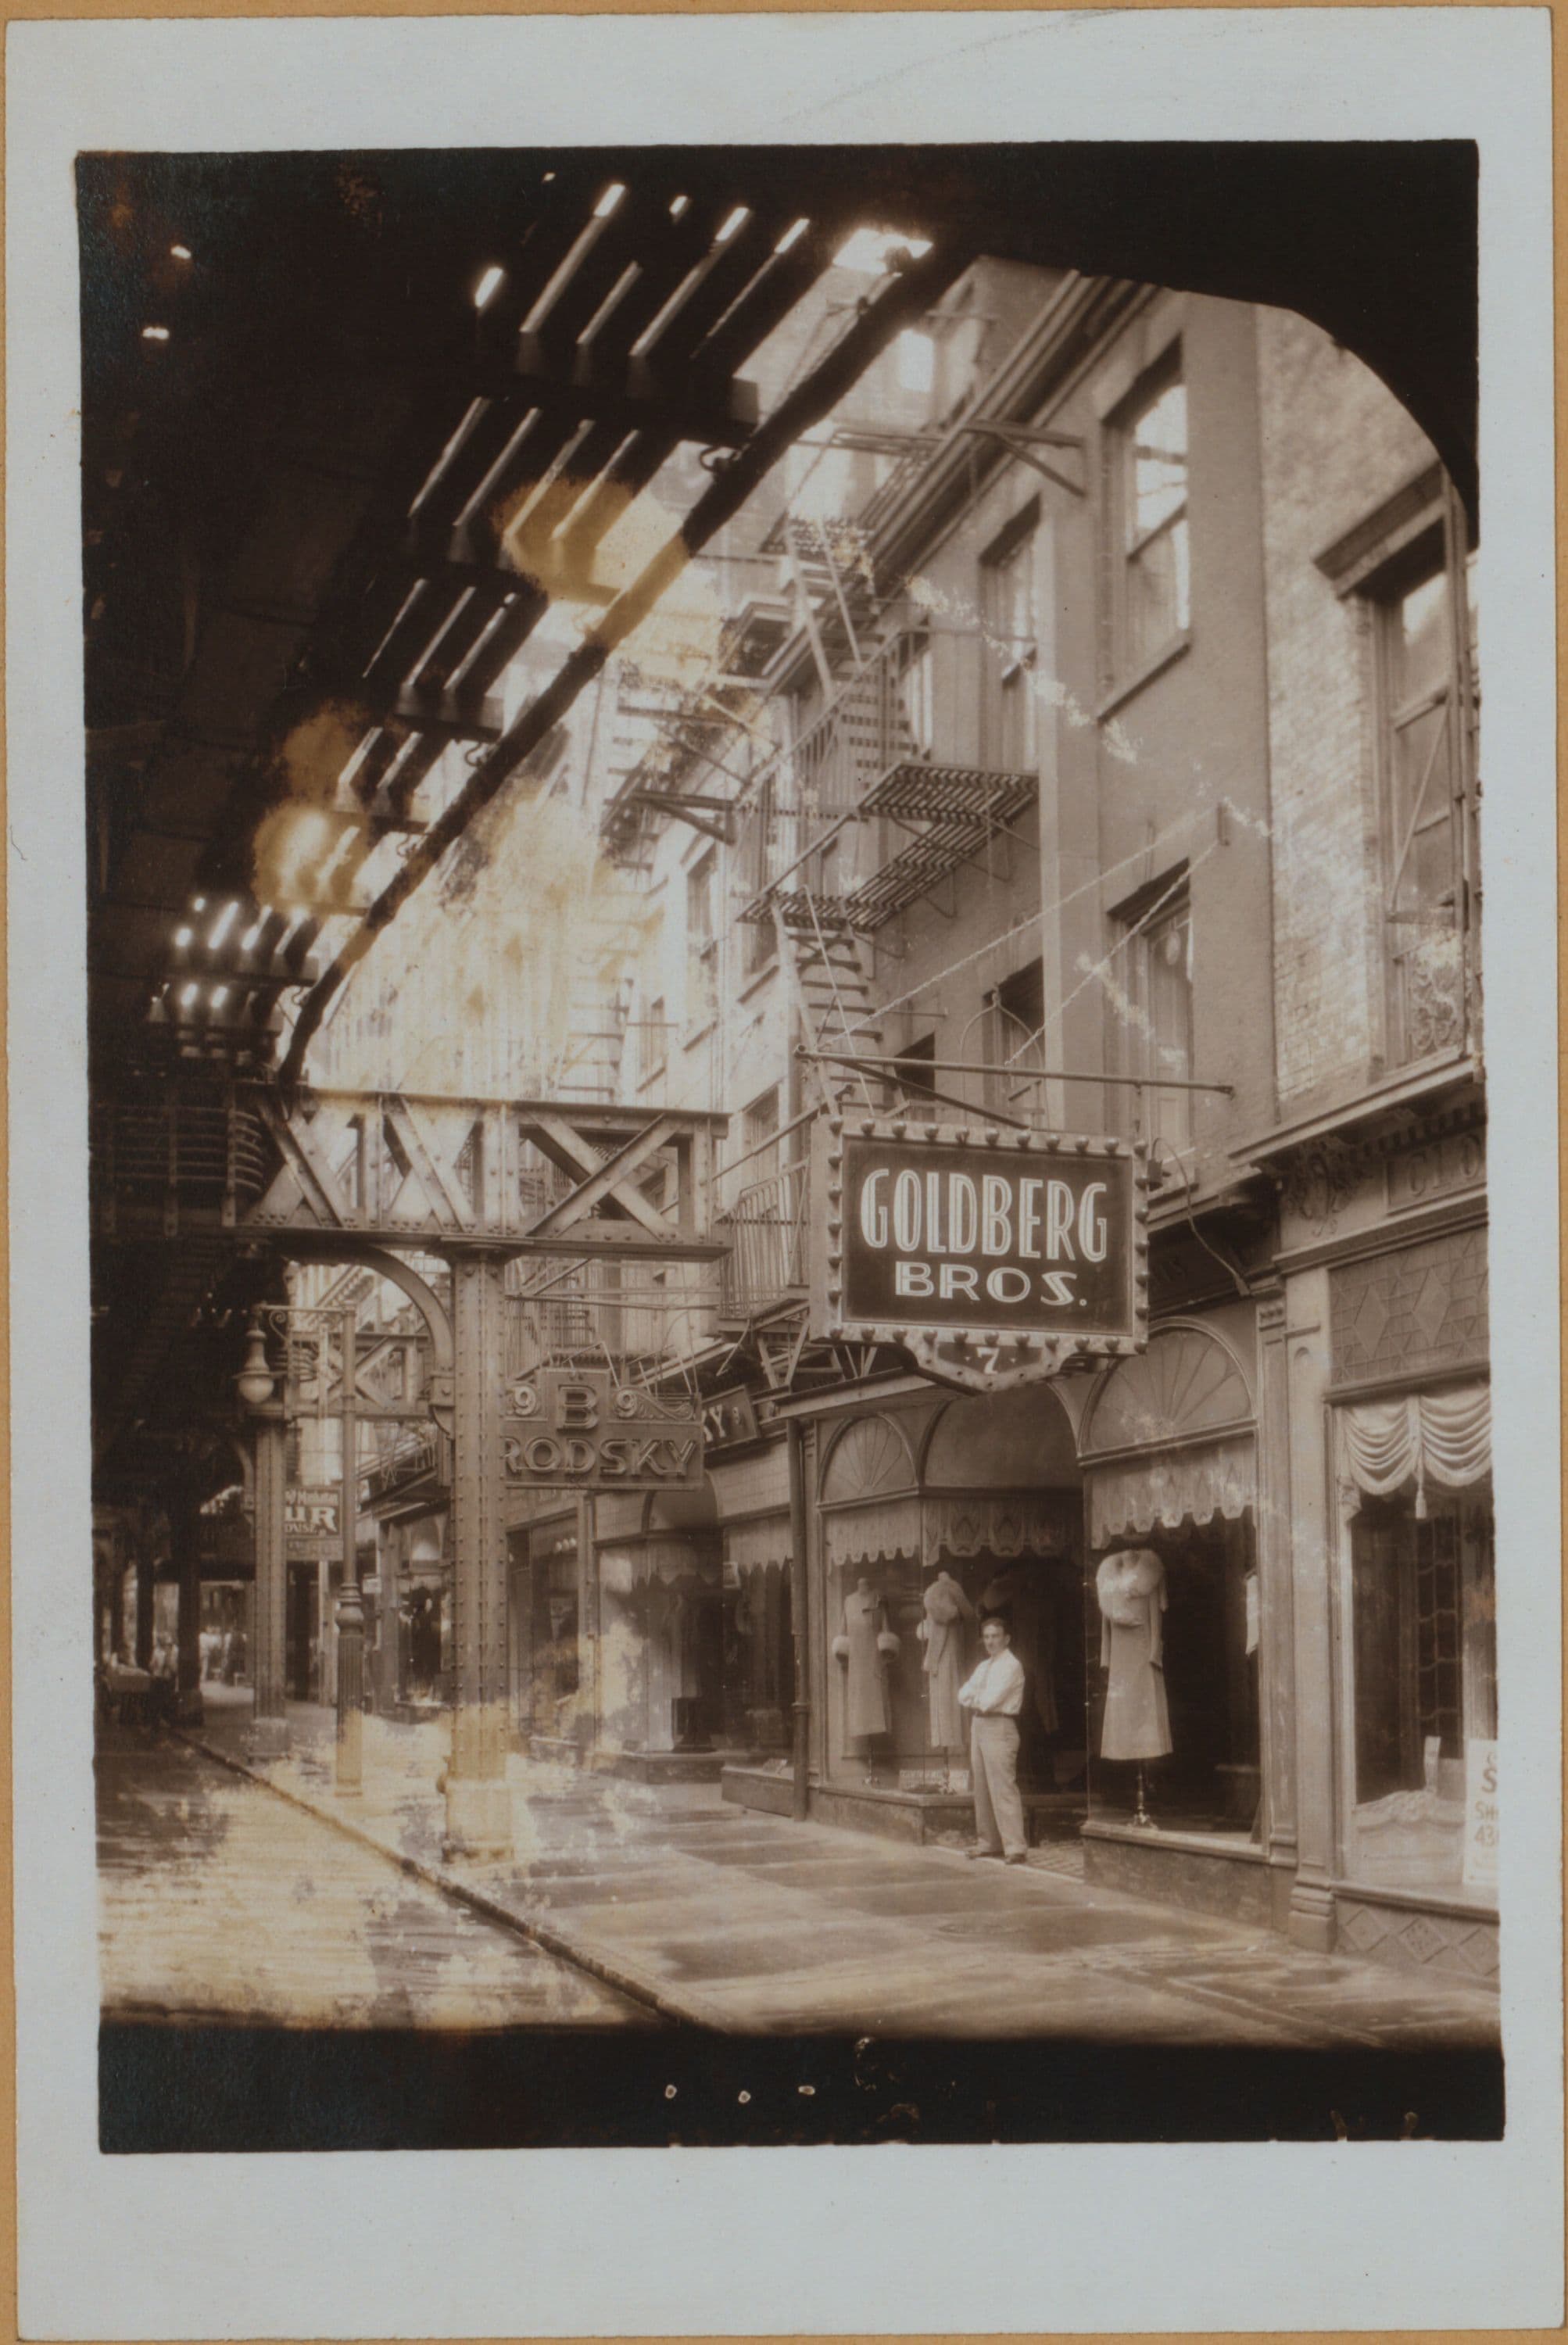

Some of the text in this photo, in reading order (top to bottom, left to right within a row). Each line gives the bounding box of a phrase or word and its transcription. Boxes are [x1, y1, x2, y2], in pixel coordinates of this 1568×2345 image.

[861, 1168, 1108, 1262] GOLDBERG
[895, 1261, 1087, 1306] BROS.
[976, 1347, 1000, 1376] 7
